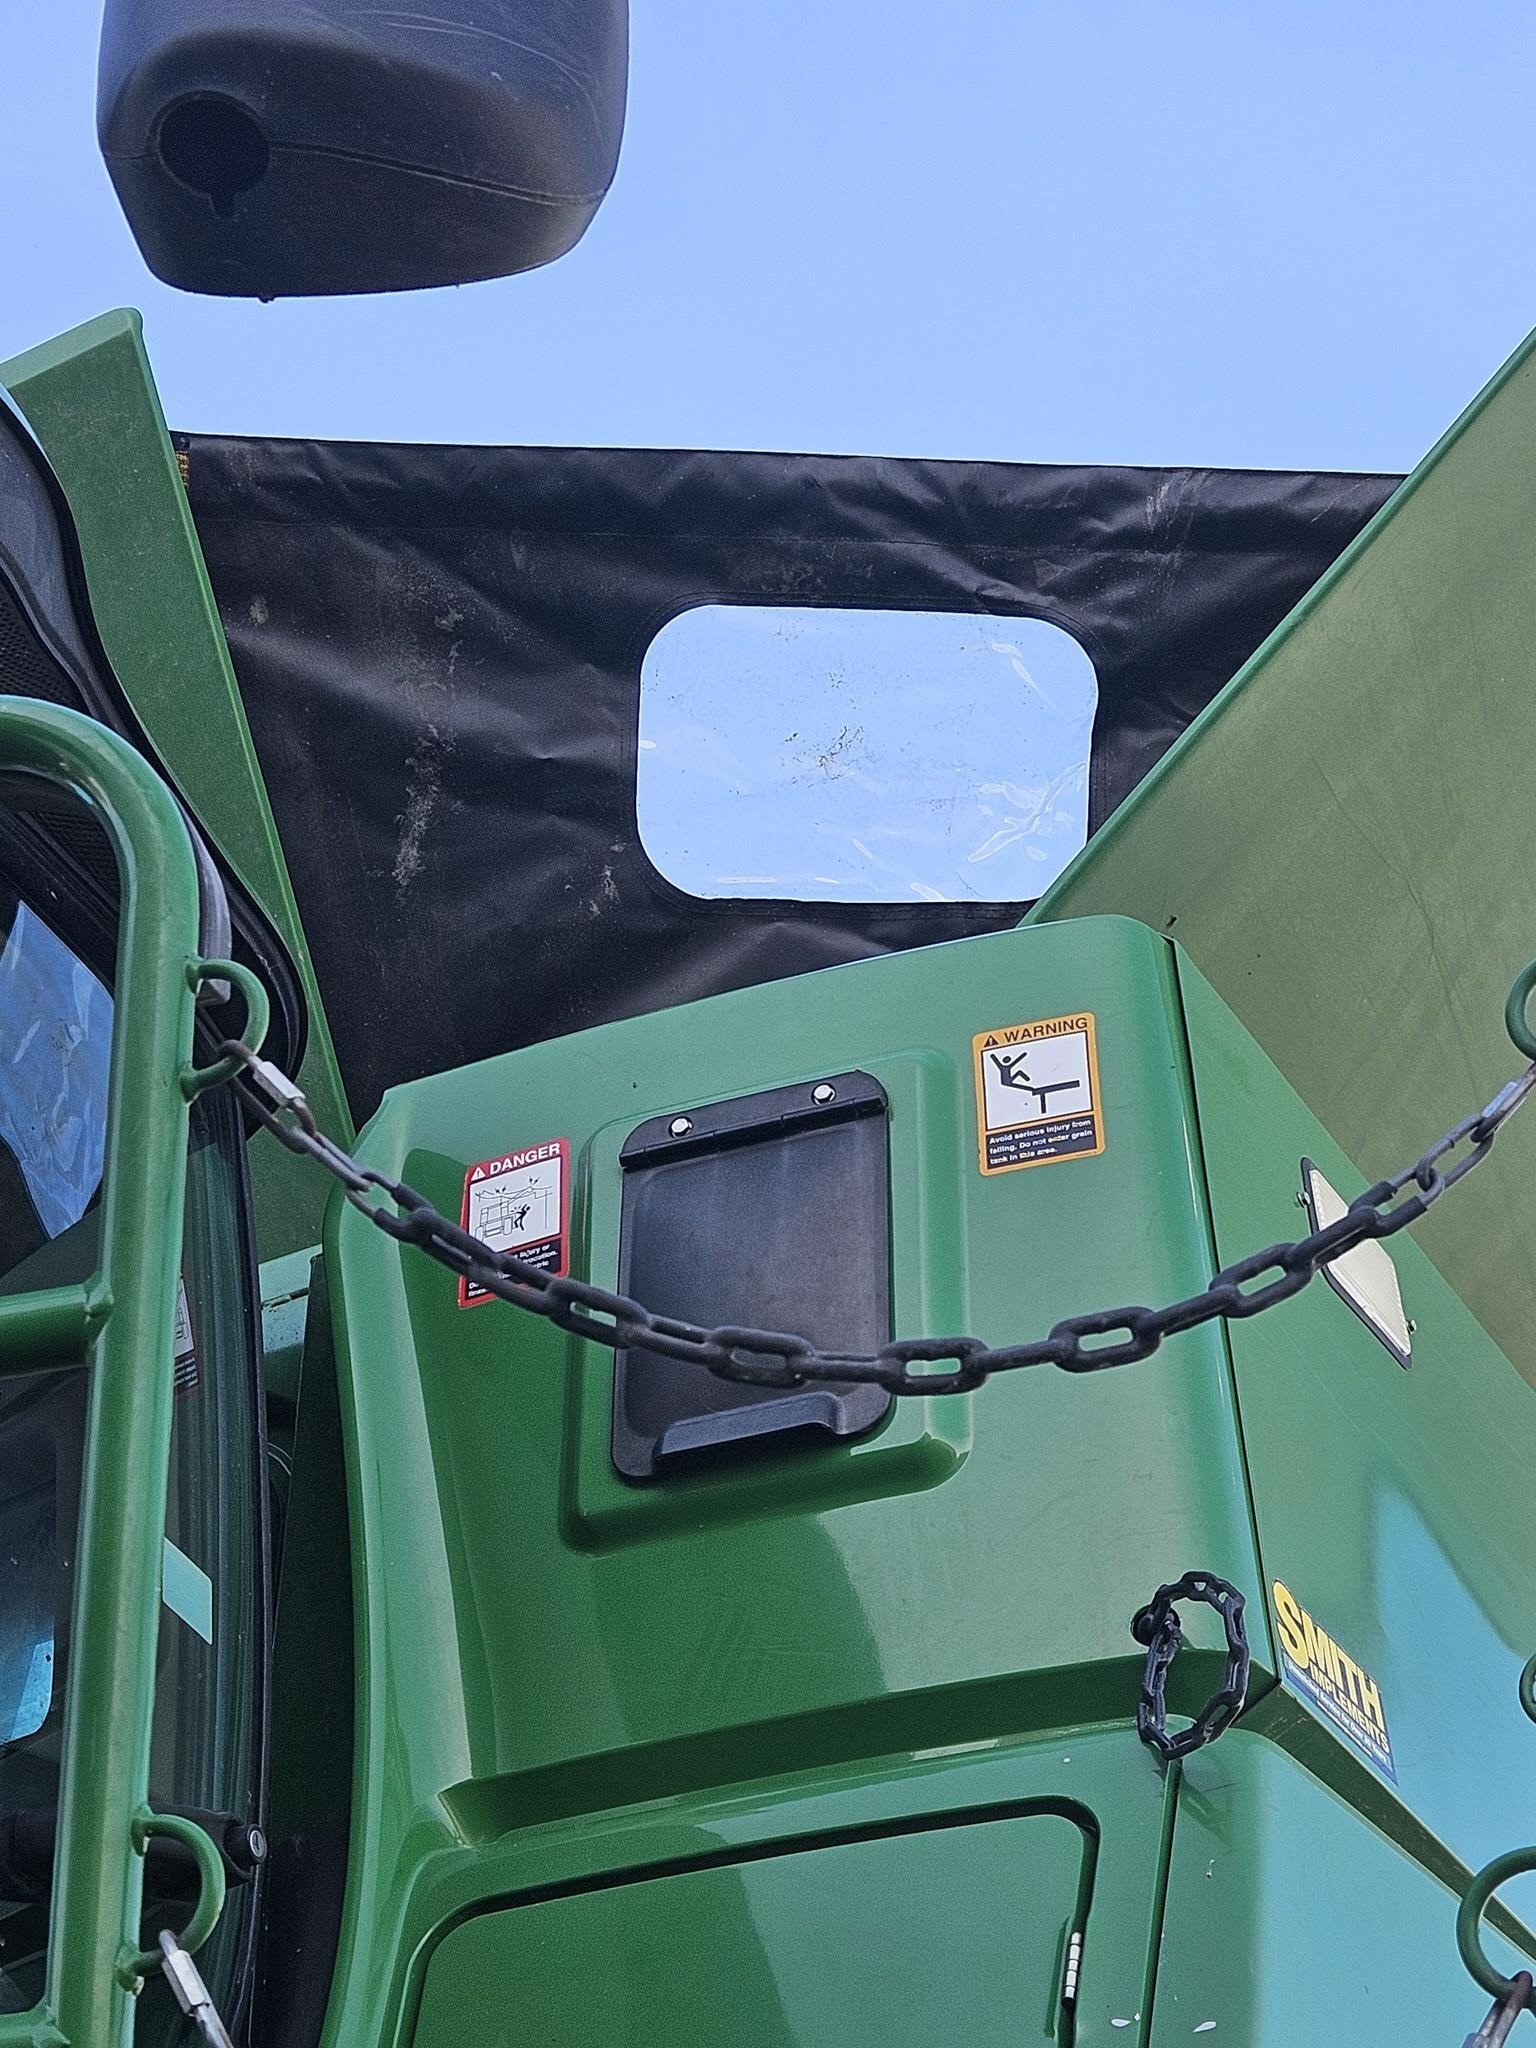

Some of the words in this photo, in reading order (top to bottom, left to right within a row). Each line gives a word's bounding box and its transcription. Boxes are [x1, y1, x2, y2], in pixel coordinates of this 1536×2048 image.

[1004, 1017, 1088, 1043] WARNING
[989, 1134, 1012, 1144] Avoid
[1015, 1129, 1044, 1139] serious
[1046, 1124, 1070, 1133] injury
[1072, 1120, 1091, 1128] from
[990, 1145, 1017, 1154] falling.
[1019, 1141, 1031, 1149] Do
[1033, 1138, 1046, 1146] not
[1071, 1130, 1092, 1140] grain
[489, 1142, 561, 1176] DANGER
[1272, 1580, 1386, 1734] SMITH
[1309, 1659, 1390, 1755] IMPLEMENTS
